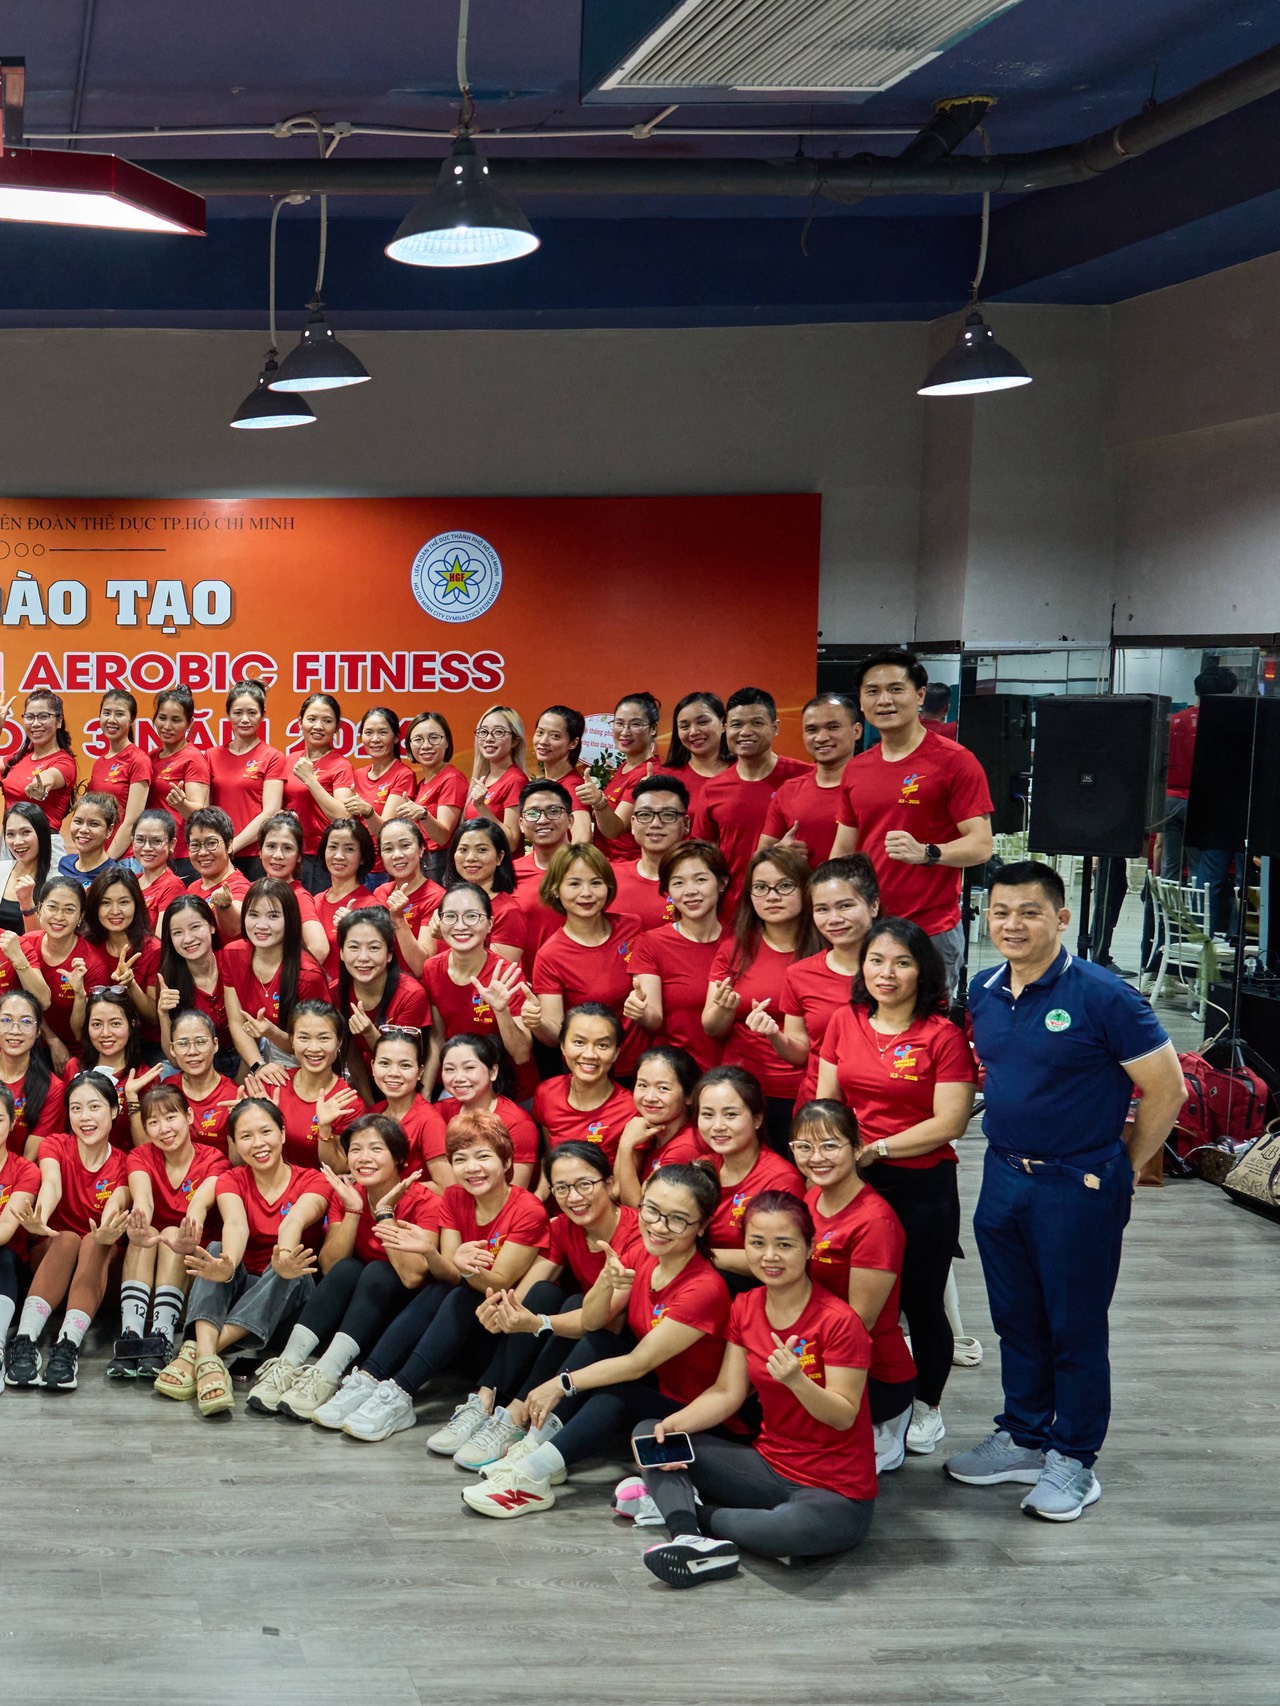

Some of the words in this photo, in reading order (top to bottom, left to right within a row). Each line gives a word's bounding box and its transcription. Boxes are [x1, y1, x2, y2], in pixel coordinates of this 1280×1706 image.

[27, 512, 78, 531] ĐOÀN
[81, 511, 116, 531] THỂ
[120, 516, 156, 534] DỤC
[215, 512, 245, 531] CHÍ
[249, 516, 295, 531] MINH
[449, 573, 465, 582] HGF
[105, 579, 232, 634] TẠO
[20, 651, 278, 692] AEROBIC
[293, 650, 505, 692] FITNESS
[134, 1304, 146, 1319] 12
